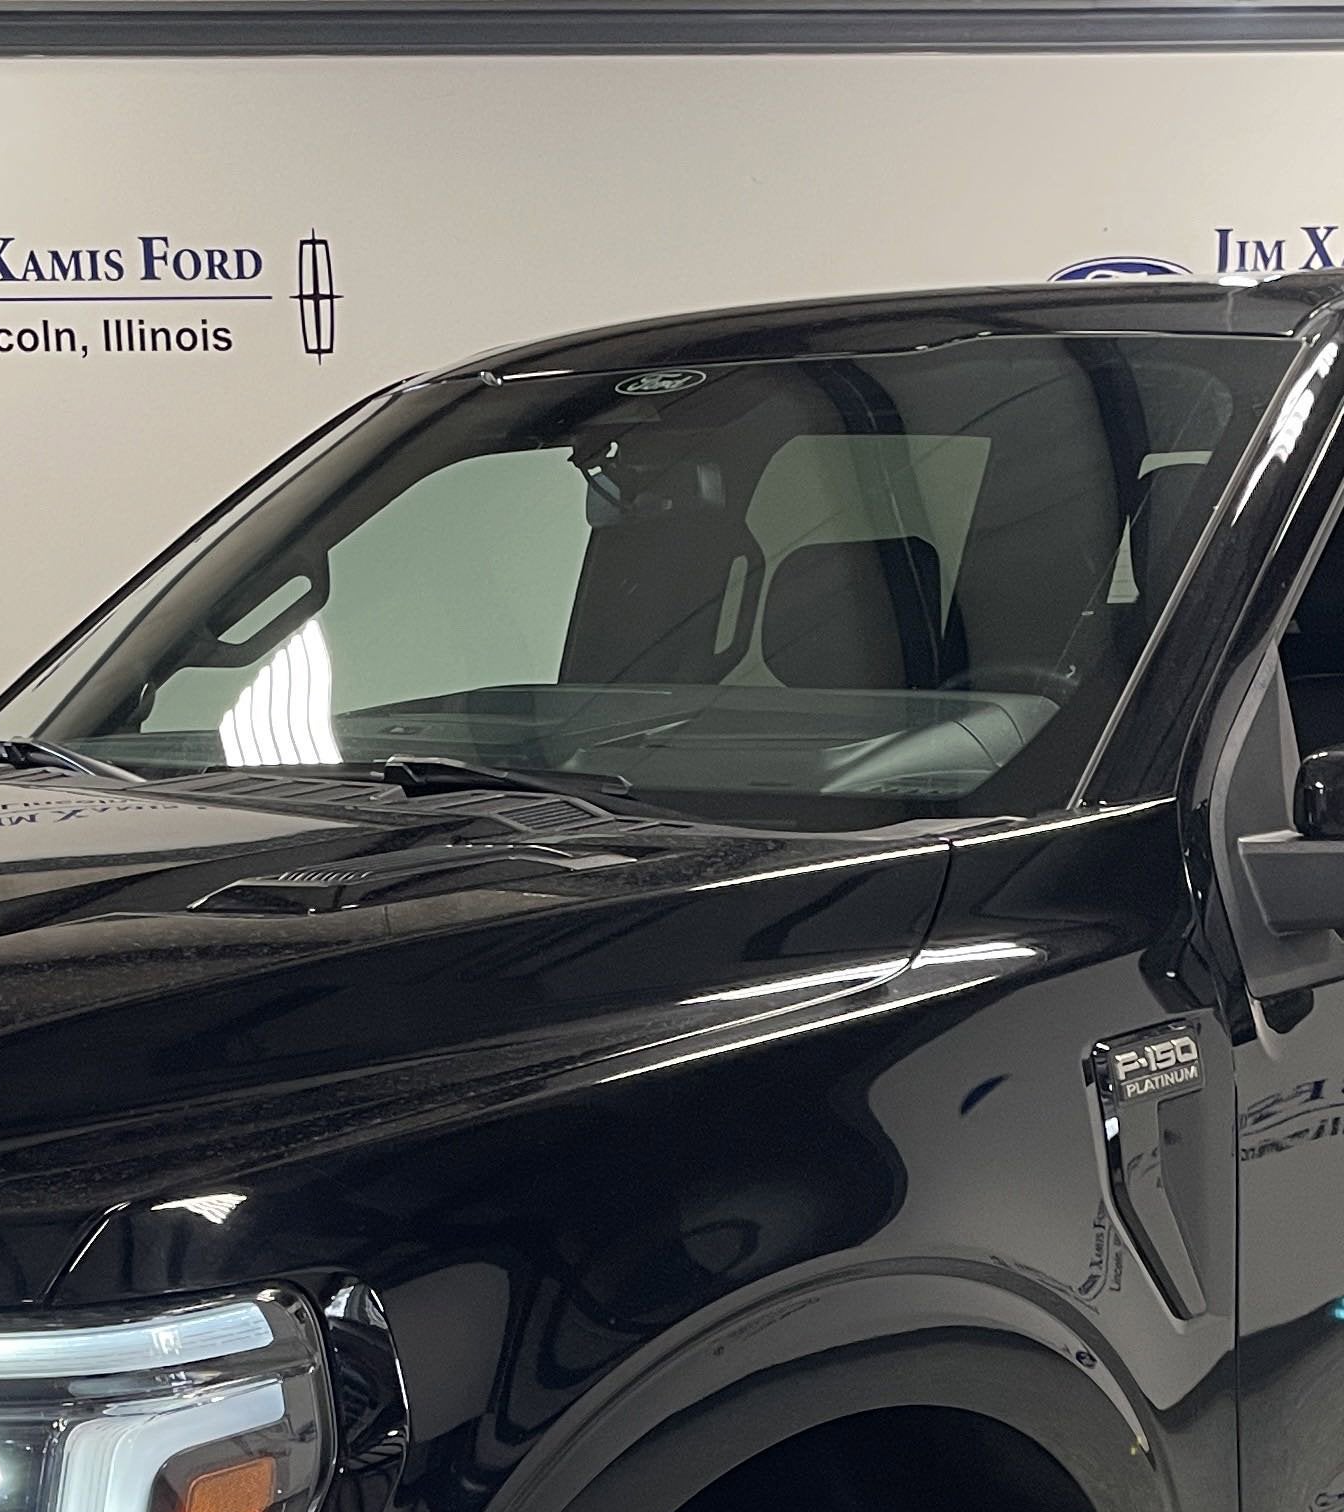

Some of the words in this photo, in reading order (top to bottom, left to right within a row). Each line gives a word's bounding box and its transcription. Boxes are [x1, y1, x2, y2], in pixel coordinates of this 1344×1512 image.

[138, 235, 263, 281] FORD
[103, 318, 233, 353] Illinois
[627, 373, 693, 391] Ford
[1115, 1036, 1197, 1080] F-150
[1126, 1065, 1198, 1097] PLATINUM
